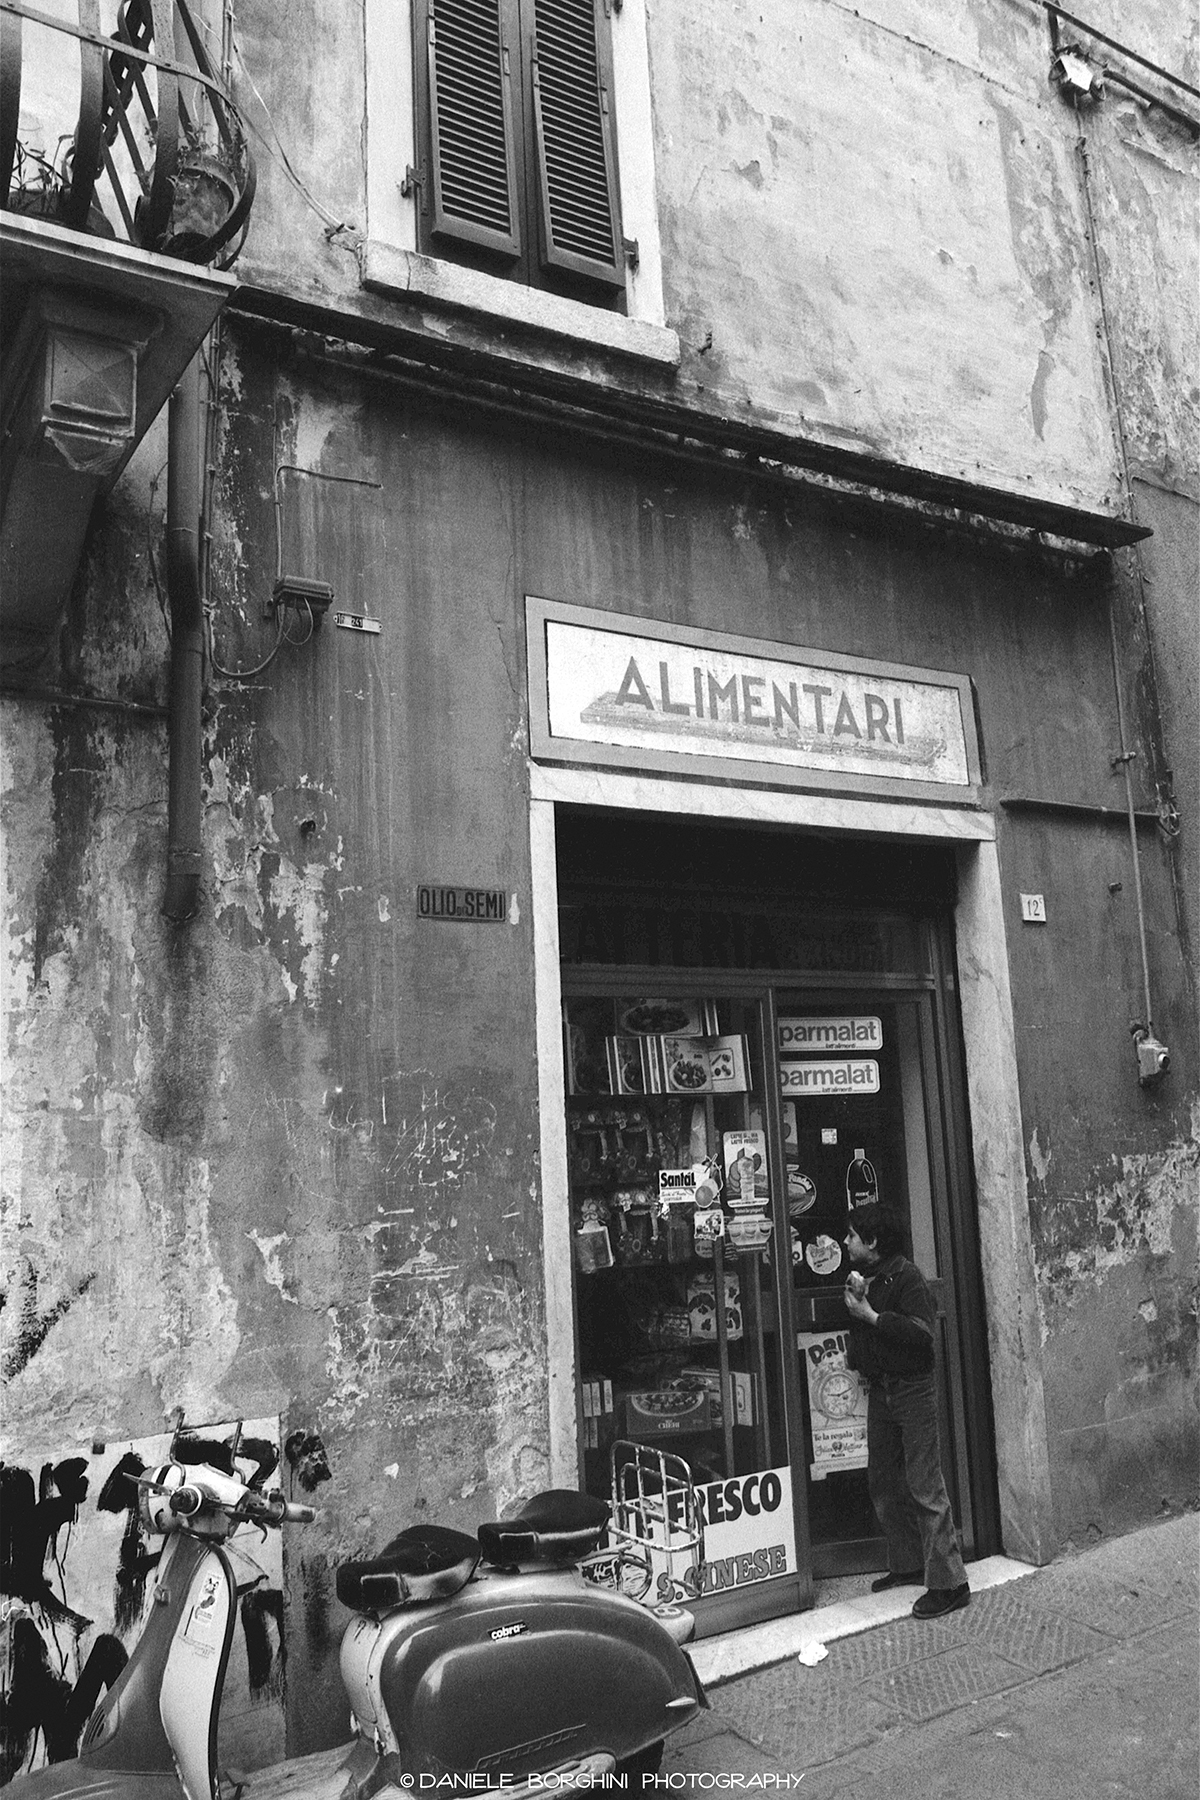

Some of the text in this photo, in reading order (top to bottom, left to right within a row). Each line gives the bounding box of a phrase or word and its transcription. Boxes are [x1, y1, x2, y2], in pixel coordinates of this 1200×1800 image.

[615, 656, 905, 744] ALIMENTARI
[420, 888, 456, 915] OLIO
[465, 891, 502, 918] SEMI
[1027, 899, 1040, 916] 12
[780, 1021, 877, 1046] parmalat
[780, 1064, 874, 1087] parmalat
[661, 1172, 696, 1187] Santál
[663, 1473, 782, 1535] FRESCO
[491, 1624, 521, 1640] cobra
